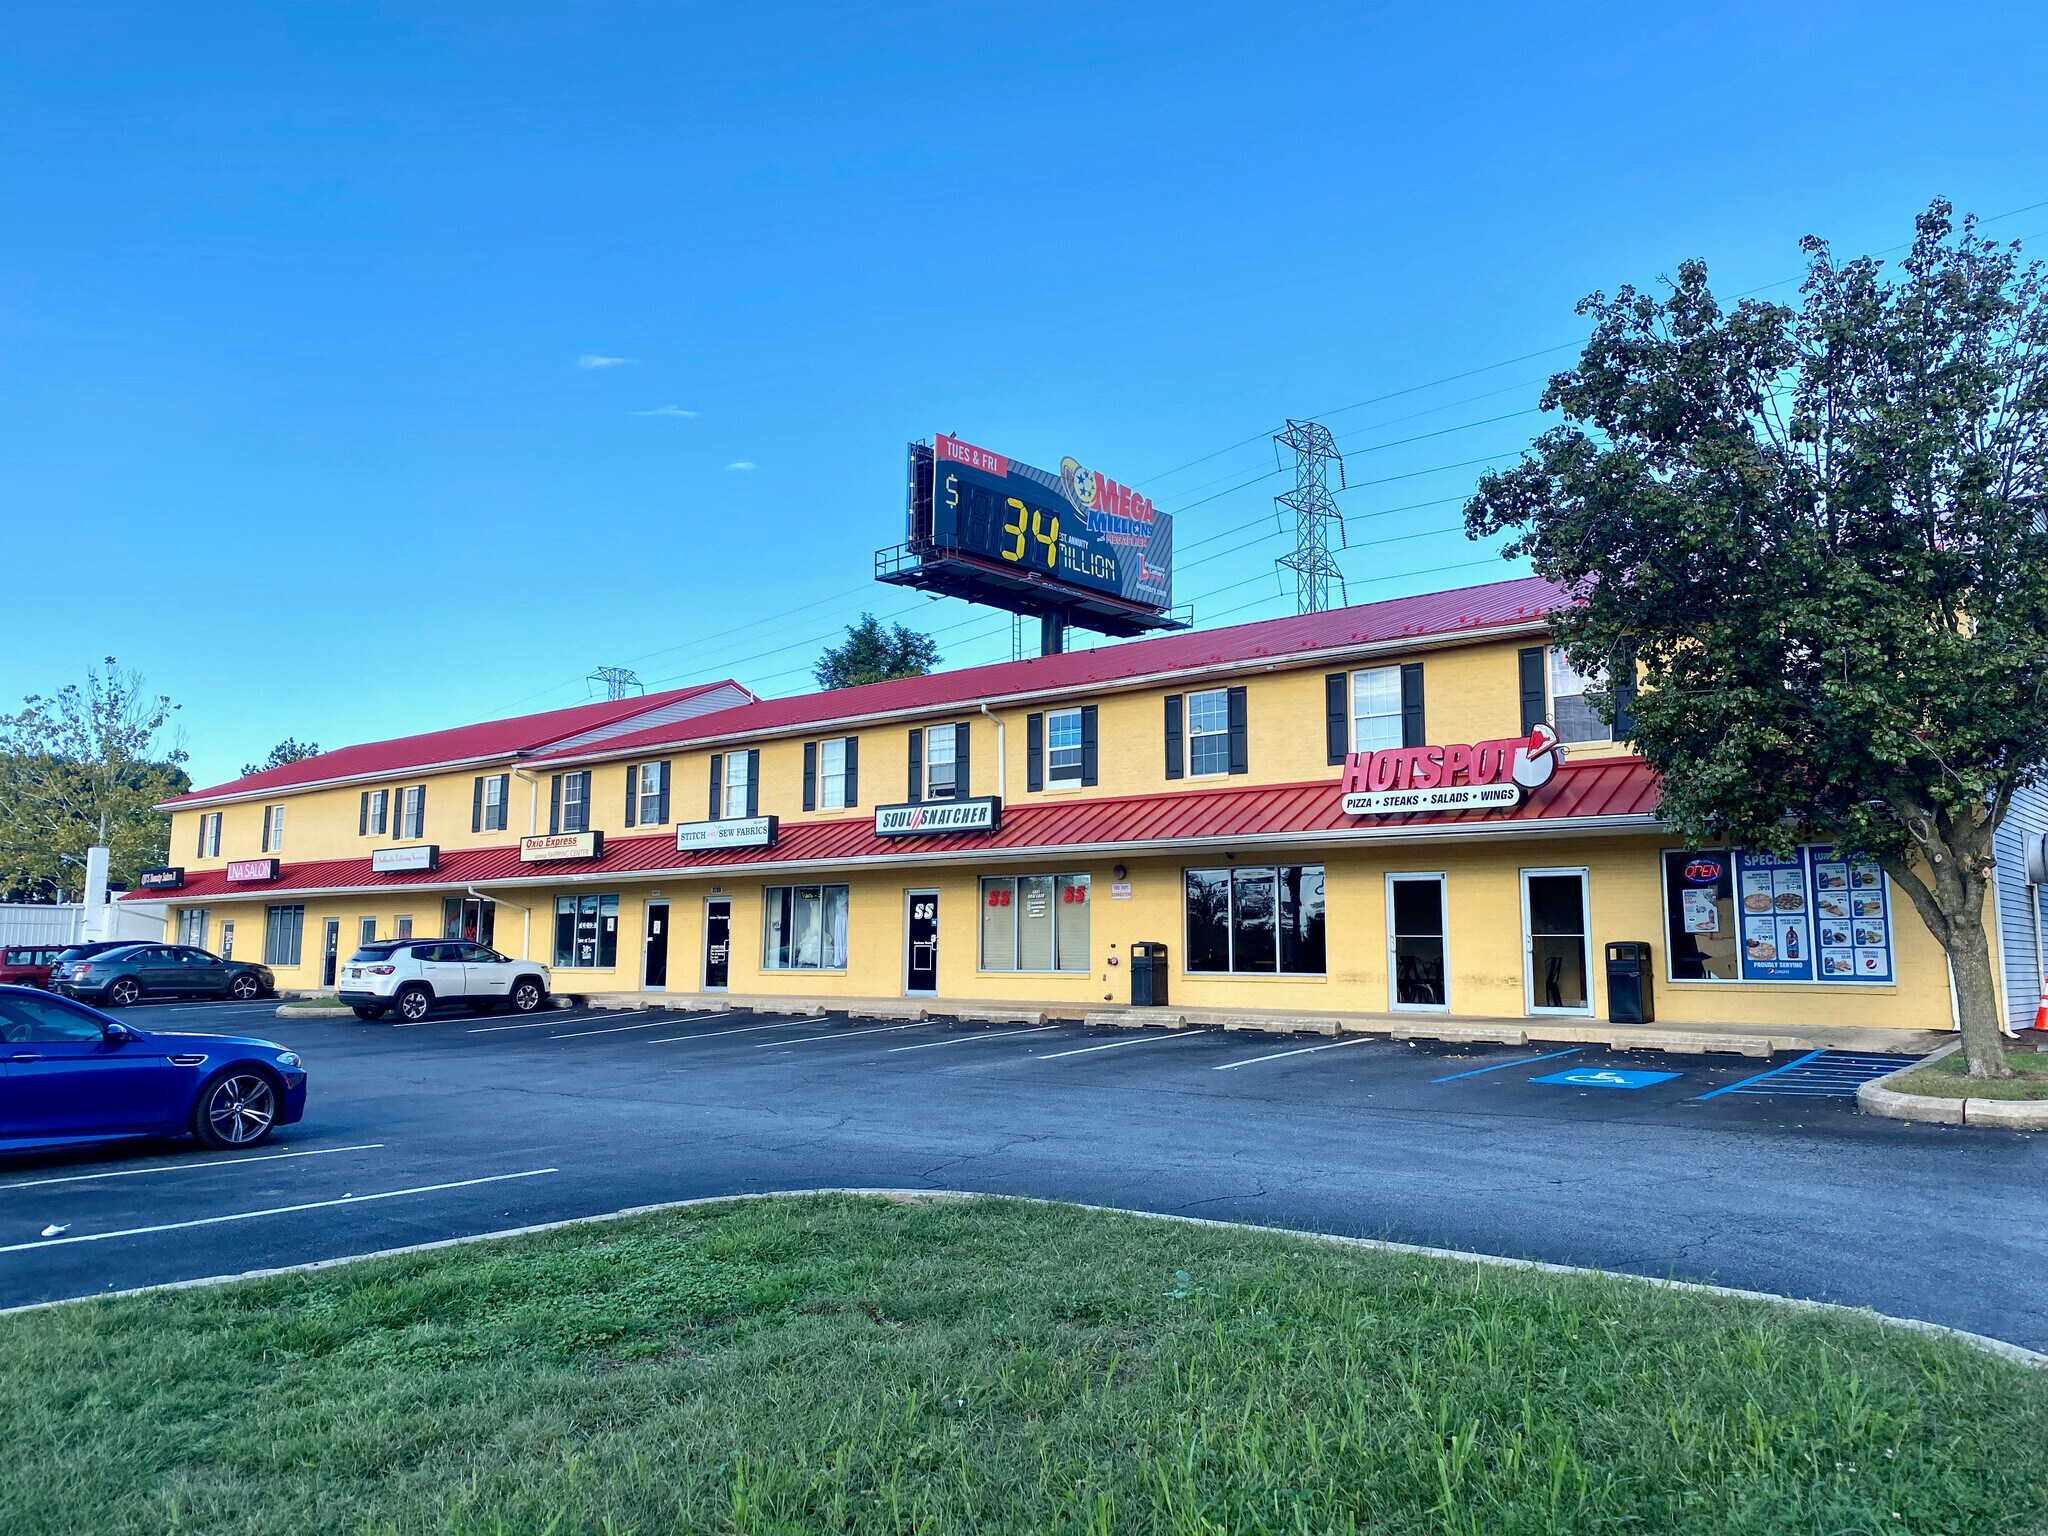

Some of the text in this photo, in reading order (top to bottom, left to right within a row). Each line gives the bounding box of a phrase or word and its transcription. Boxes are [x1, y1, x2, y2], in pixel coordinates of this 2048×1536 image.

[946, 441, 998, 472] TUES & FRI
[1090, 471, 1153, 524] MEGA
[946, 473, 1060, 568] $ 34
[1086, 509, 1153, 538] MILLIONS
[1068, 536, 1088, 550] ANNUITY
[1060, 543, 1116, 581] MILLION
[1341, 737, 1534, 794] HOTSPOT
[1346, 790, 1514, 809] PIZZA STEAKS SALADS WINGS
[882, 807, 988, 828] SOUL SNATCHER
[526, 837, 577, 848] Oxio Express
[681, 832, 706, 841] STITCH
[718, 828, 735, 838] SEW
[736, 826, 768, 836] FABRICS
[228, 862, 270, 879] LNA SALON
[1684, 864, 1720, 878] OPEN
[988, 889, 1011, 907] SS
[1063, 885, 1087, 903] SS
[914, 903, 935, 919] SS
